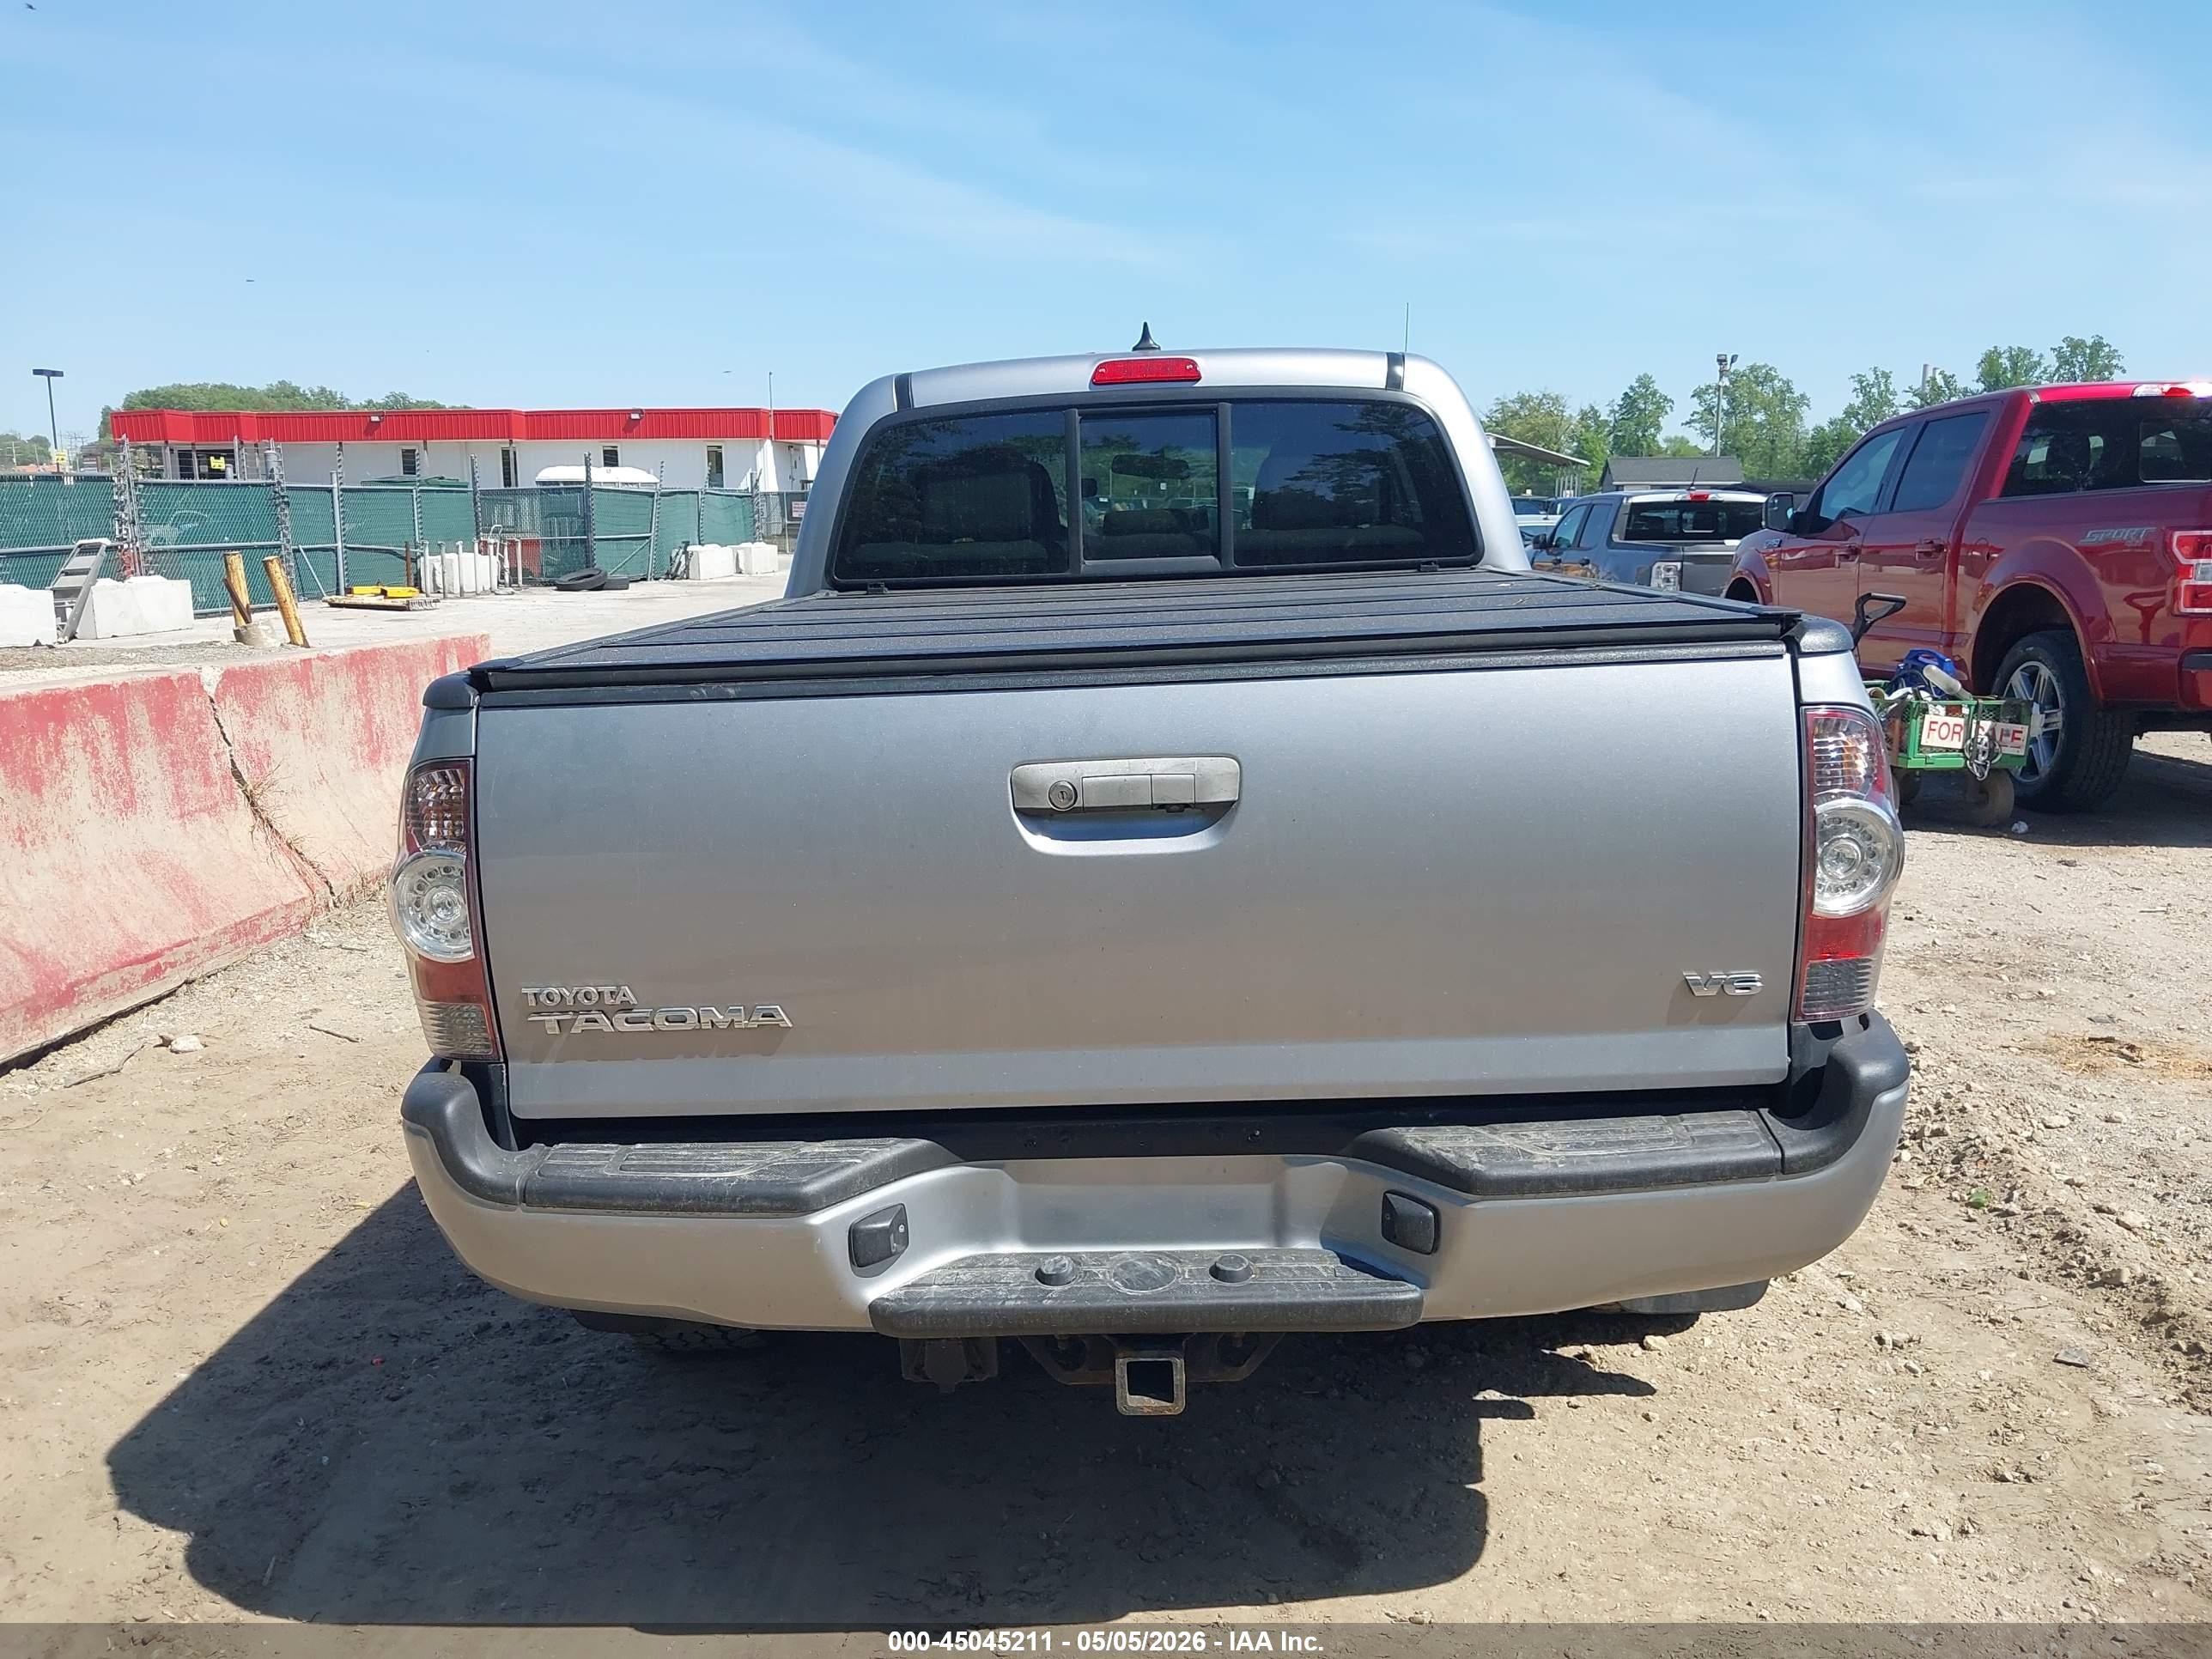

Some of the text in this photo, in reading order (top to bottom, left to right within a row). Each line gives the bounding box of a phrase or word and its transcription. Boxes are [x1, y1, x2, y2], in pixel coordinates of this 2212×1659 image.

[2079, 526, 2157, 544] SPORT
[1927, 720, 1964, 743] FOR
[1682, 970, 1765, 997] V6
[521, 986, 638, 1006] TOYOTA
[527, 1005, 793, 1035] TACOMA
